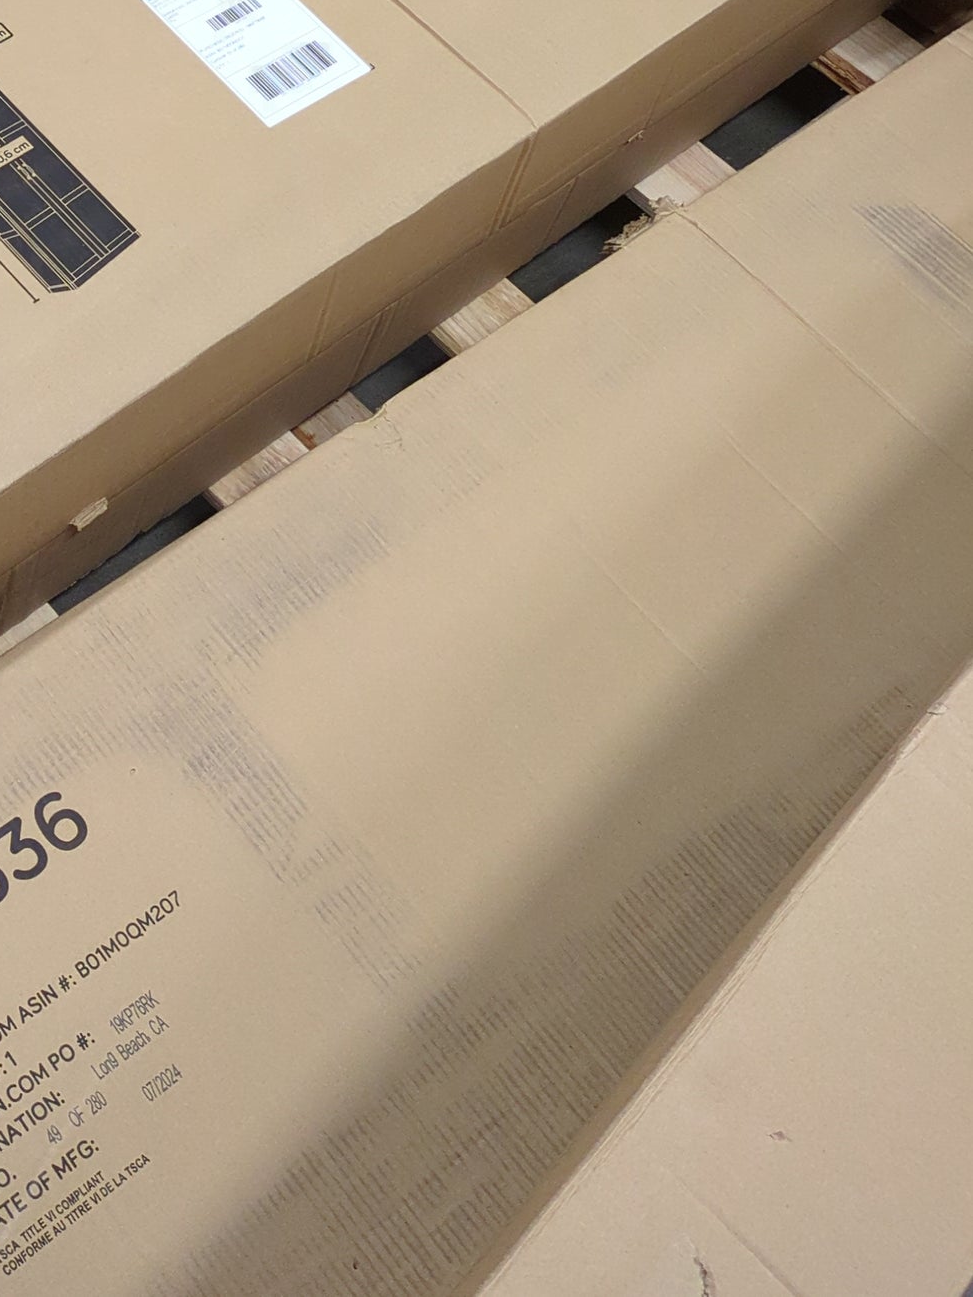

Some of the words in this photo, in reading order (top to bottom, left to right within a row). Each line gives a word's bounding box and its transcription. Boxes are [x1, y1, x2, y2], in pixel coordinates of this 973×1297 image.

[13, 140, 31, 154] cm
[17, 983, 59, 1024] ASIN
[58, 974, 77, 993] #:
[4, 1050, 18, 1068] 1
[47, 1043, 76, 1072] PO
[77, 1032, 96, 1051] #:
[90, 1052, 120, 1080] Long
[148, 1014, 170, 1037] CA
[26, 1170, 51, 1200] OF
[51, 1138, 100, 1180] MFG:
[140, 1063, 183, 1103] 07/2024
[46, 1124, 63, 1145] 49
[68, 1106, 85, 1128] OF
[84, 1090, 108, 1116] 280
[2, 1232, 53, 1276] CONFORME
[53, 1220, 67, 1237] AU
[64, 1200, 92, 1224] TITRE
[90, 1191, 103, 1205] VI
[101, 1180, 115, 1198] DE
[115, 1172, 128, 1188] LA
[124, 1153, 151, 1177] TSCA
[20, 1217, 47, 1243] TITLE
[44, 1209, 57, 1223] VI
[55, 1170, 105, 1216] COMPLIANT
